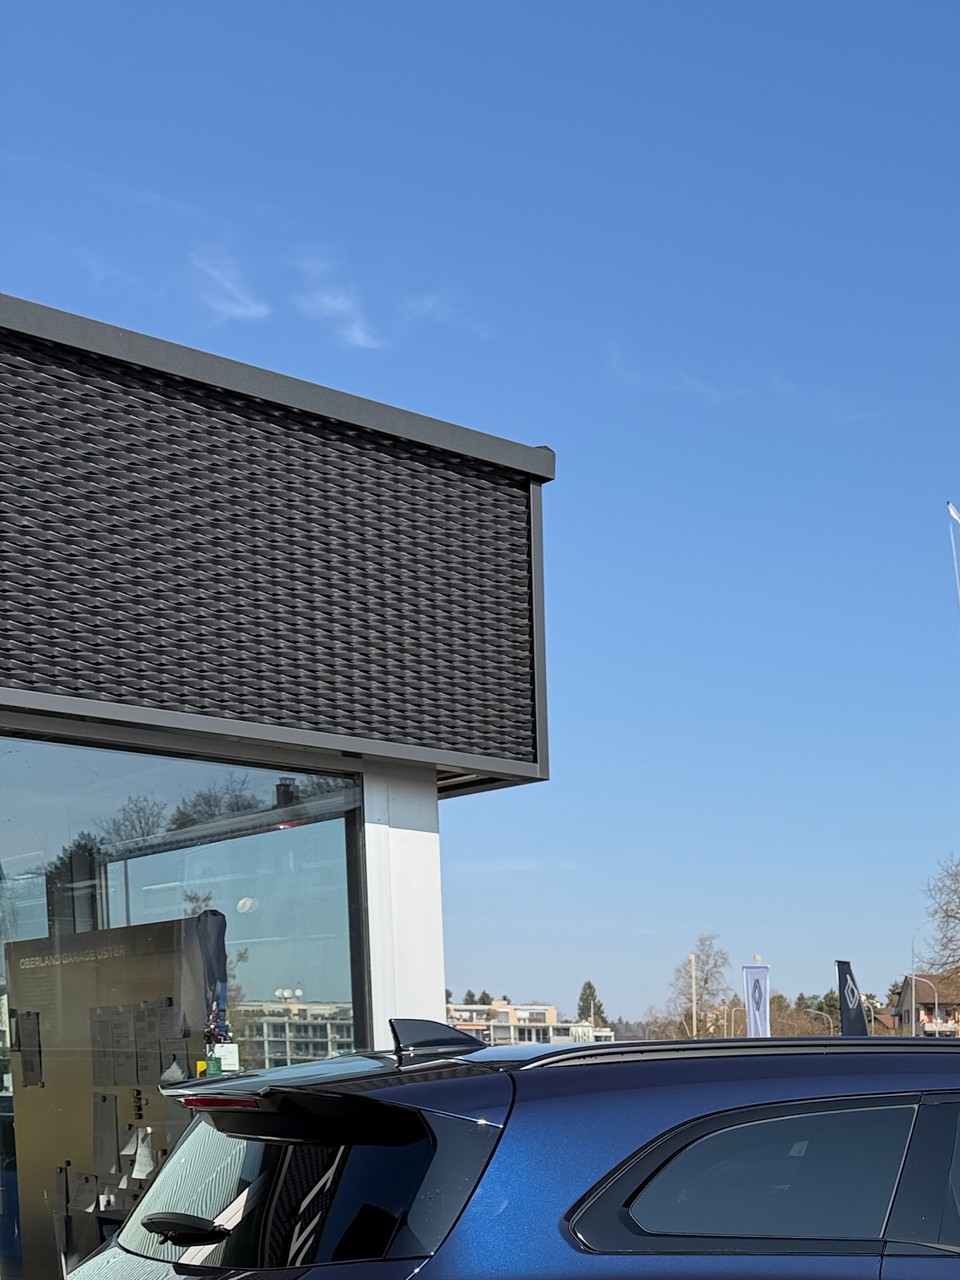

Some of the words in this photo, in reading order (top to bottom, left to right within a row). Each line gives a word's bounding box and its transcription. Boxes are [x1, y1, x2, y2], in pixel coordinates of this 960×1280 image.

[20, 953, 61, 969] OBERLAND
[62, 948, 96, 965] GARAGE
[96, 944, 126, 960] USTER
